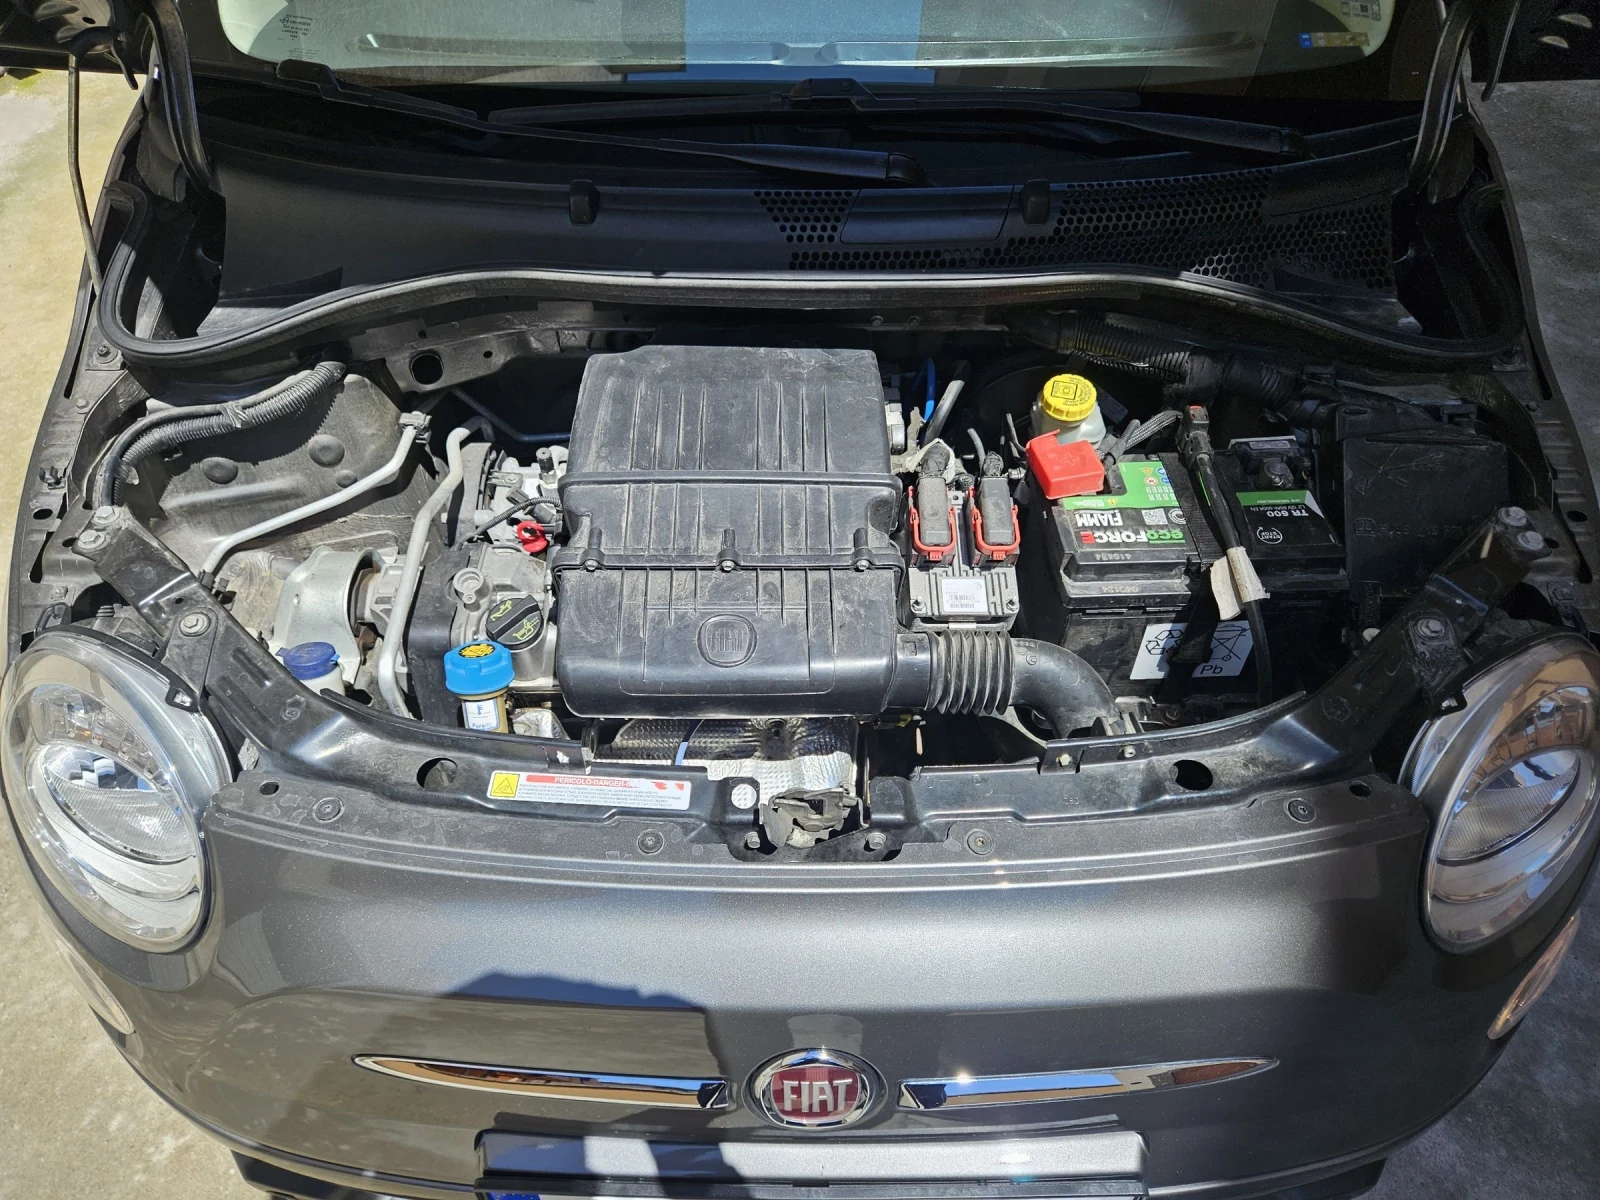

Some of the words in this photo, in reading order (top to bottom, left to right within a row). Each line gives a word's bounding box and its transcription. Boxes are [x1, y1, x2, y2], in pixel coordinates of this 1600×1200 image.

[1075, 510, 1123, 527] FIAMM
[1266, 510, 1289, 518] 600
[1291, 509, 1309, 517] TR
[1200, 664, 1223, 675] Pb
[782, 1079, 853, 1113] FIAT
